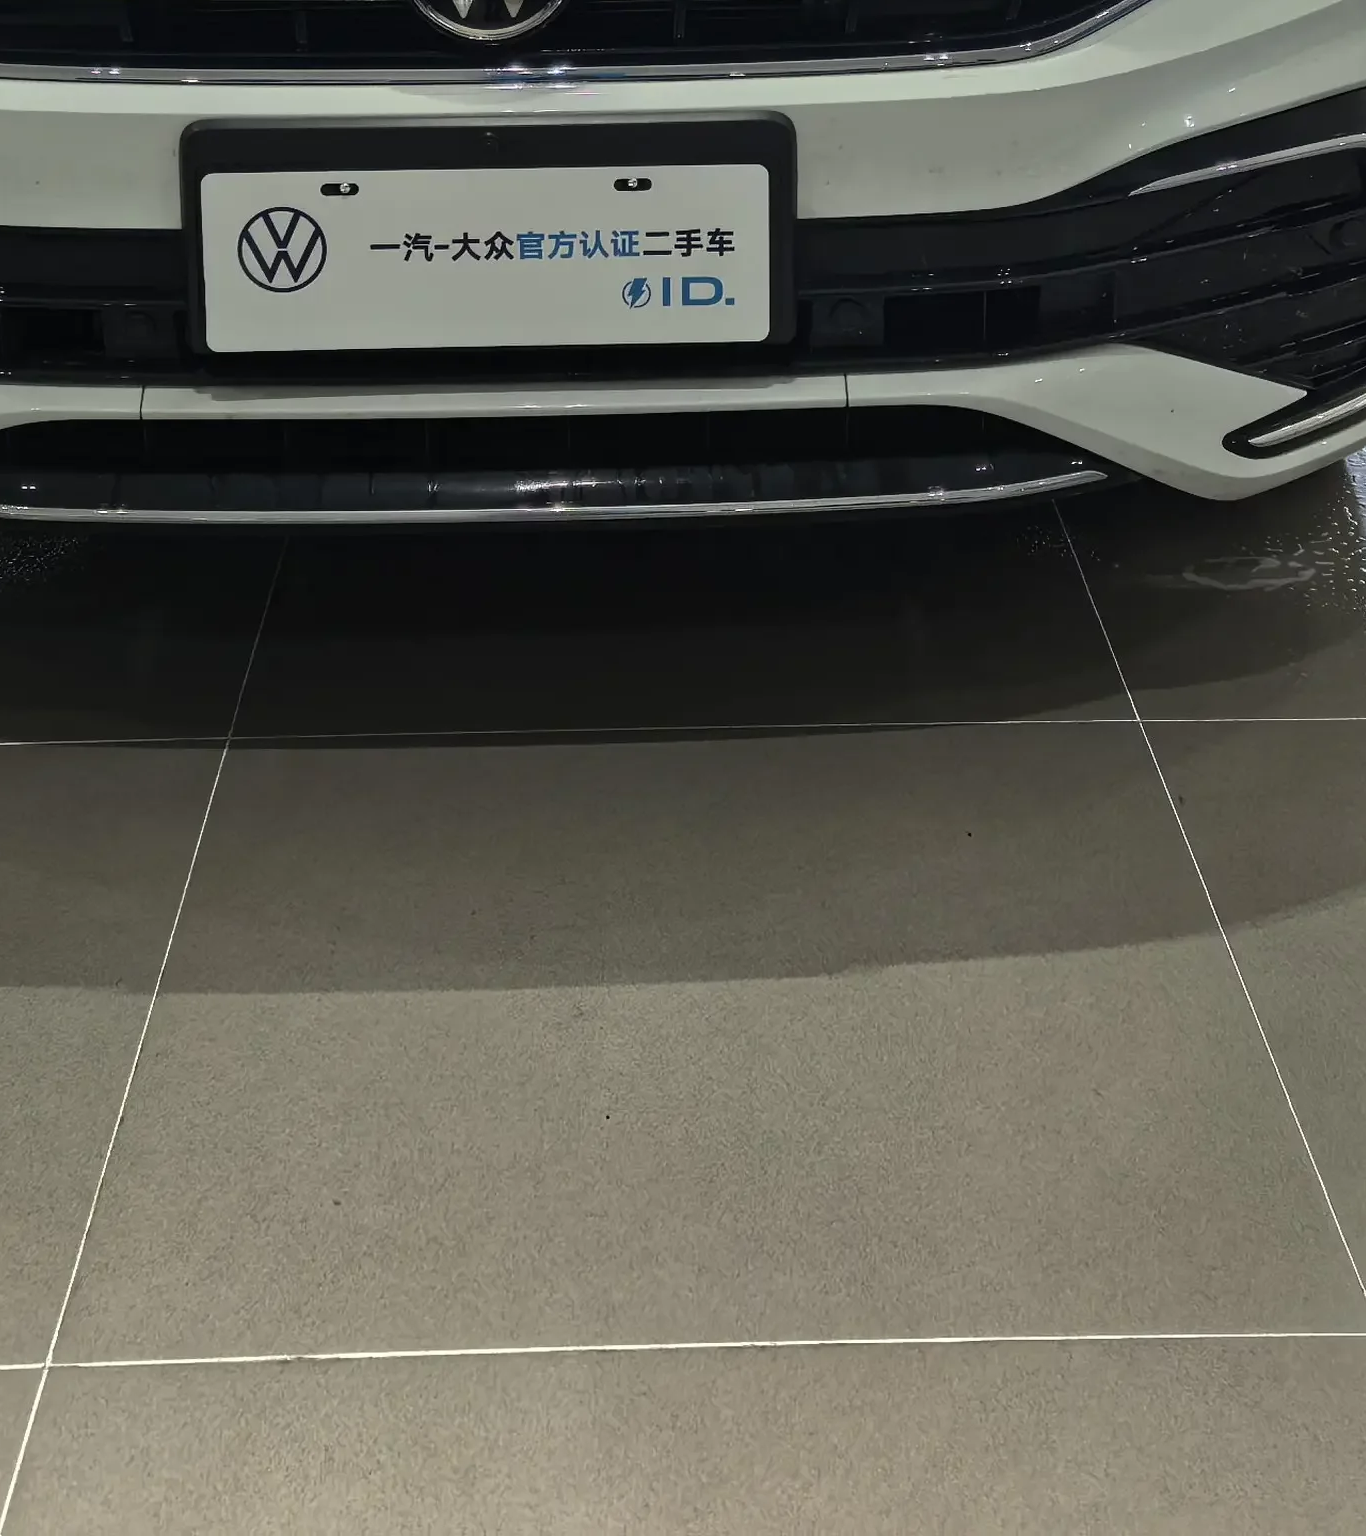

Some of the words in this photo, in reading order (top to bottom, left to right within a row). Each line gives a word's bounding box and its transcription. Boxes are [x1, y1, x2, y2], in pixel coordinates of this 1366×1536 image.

[369, 227, 736, 262] 一汽-大众官方认证二手车
[661, 276, 736, 307] ID.
